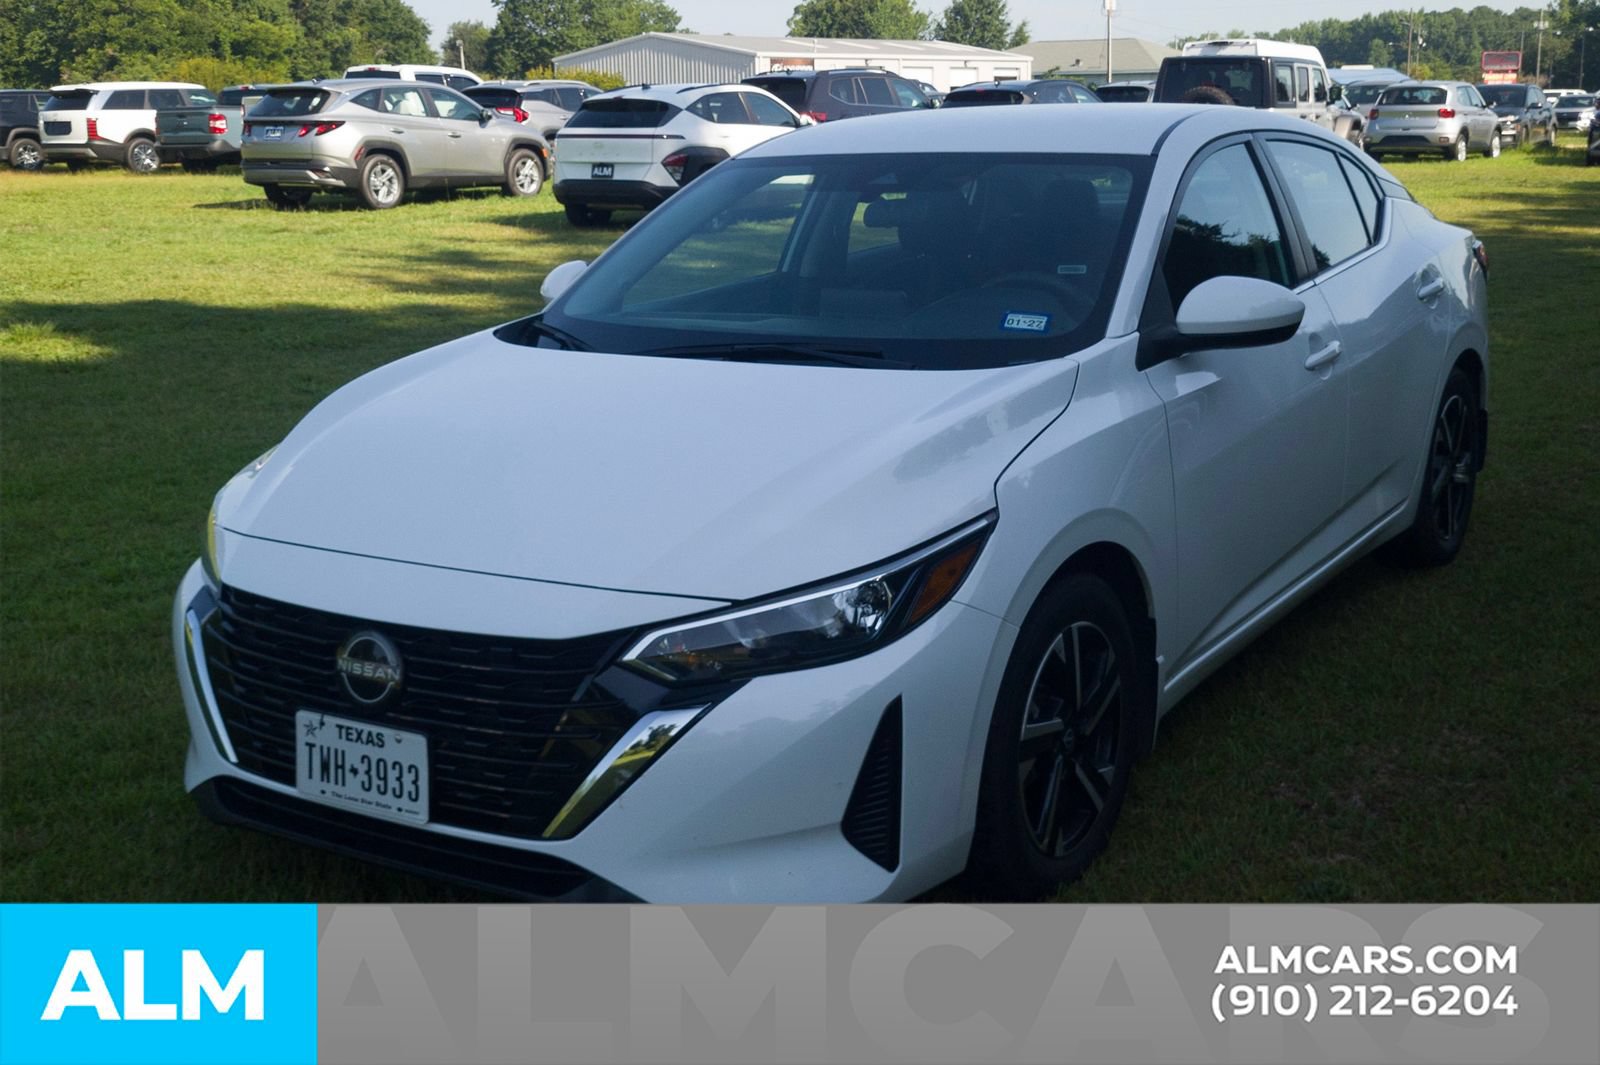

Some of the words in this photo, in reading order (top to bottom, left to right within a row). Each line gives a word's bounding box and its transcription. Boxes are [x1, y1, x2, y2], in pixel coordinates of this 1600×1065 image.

[592, 167, 612, 176] ALM
[338, 658, 401, 681] NISSAN
[335, 723, 385, 749] TEXAS
